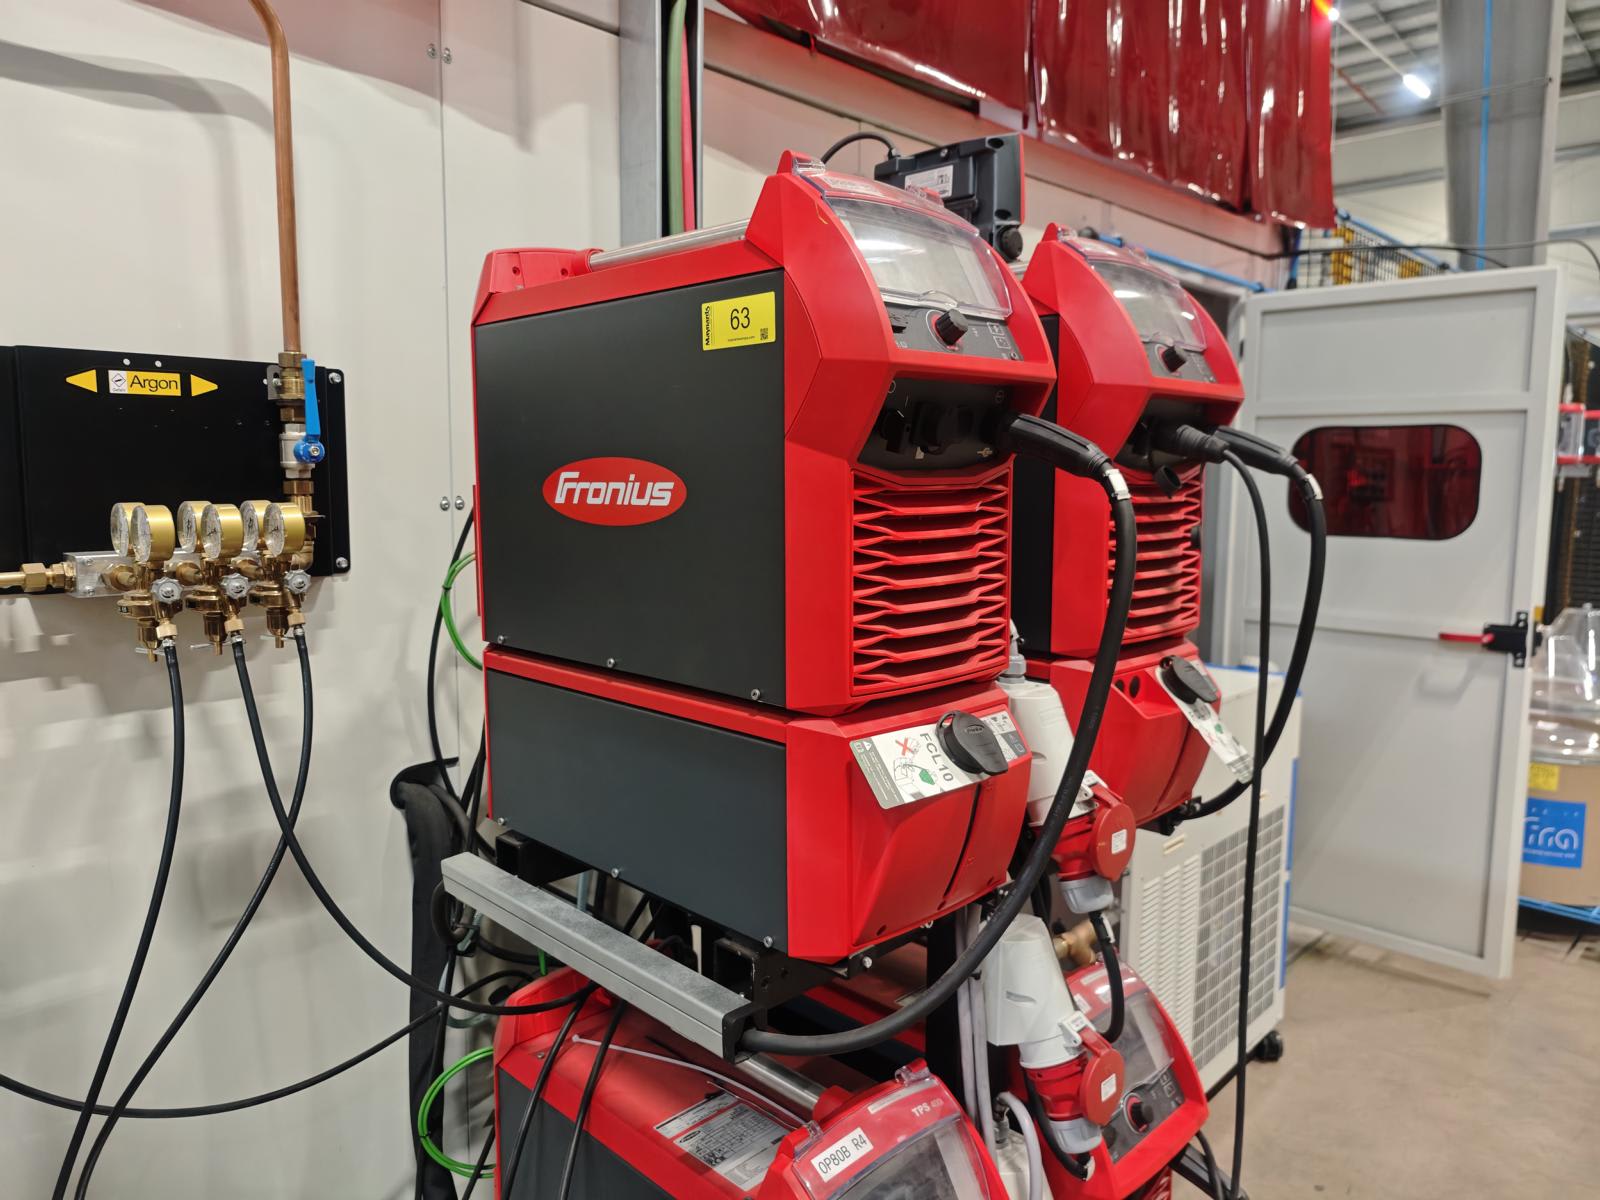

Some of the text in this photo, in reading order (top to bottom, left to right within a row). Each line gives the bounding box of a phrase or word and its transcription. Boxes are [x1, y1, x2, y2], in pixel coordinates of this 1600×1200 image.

[730, 306, 751, 331] 63
[130, 374, 179, 392] Argon
[554, 471, 675, 507] Fronius
[919, 732, 954, 782] FCL10
[911, 1102, 931, 1117] TPS
[851, 1133, 868, 1151] R4
